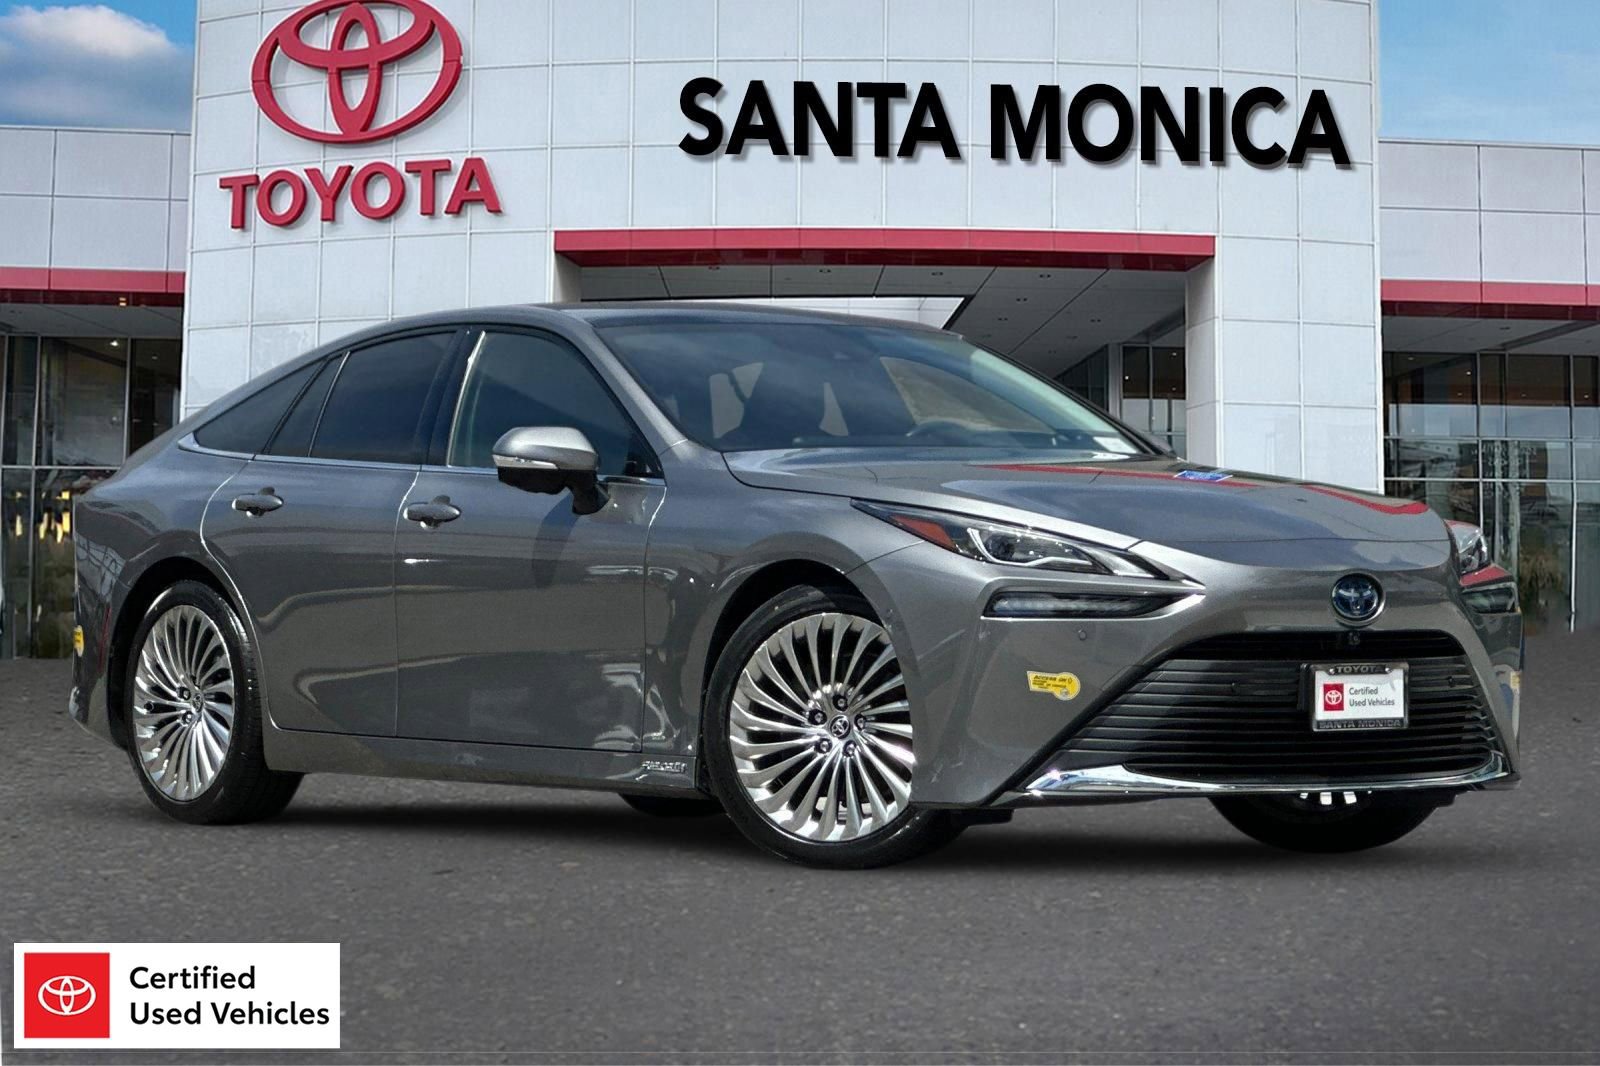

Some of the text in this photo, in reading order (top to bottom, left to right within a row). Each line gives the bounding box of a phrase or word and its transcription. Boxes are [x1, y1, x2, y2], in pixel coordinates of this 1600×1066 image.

[679, 78, 1351, 169] SANTA MONICA
[219, 157, 502, 229] TOYOTA
[1349, 687, 1378, 695] Certified
[1349, 697, 1395, 707] Used Vehicles
[1319, 719, 1401, 729] SANTA MONICA
